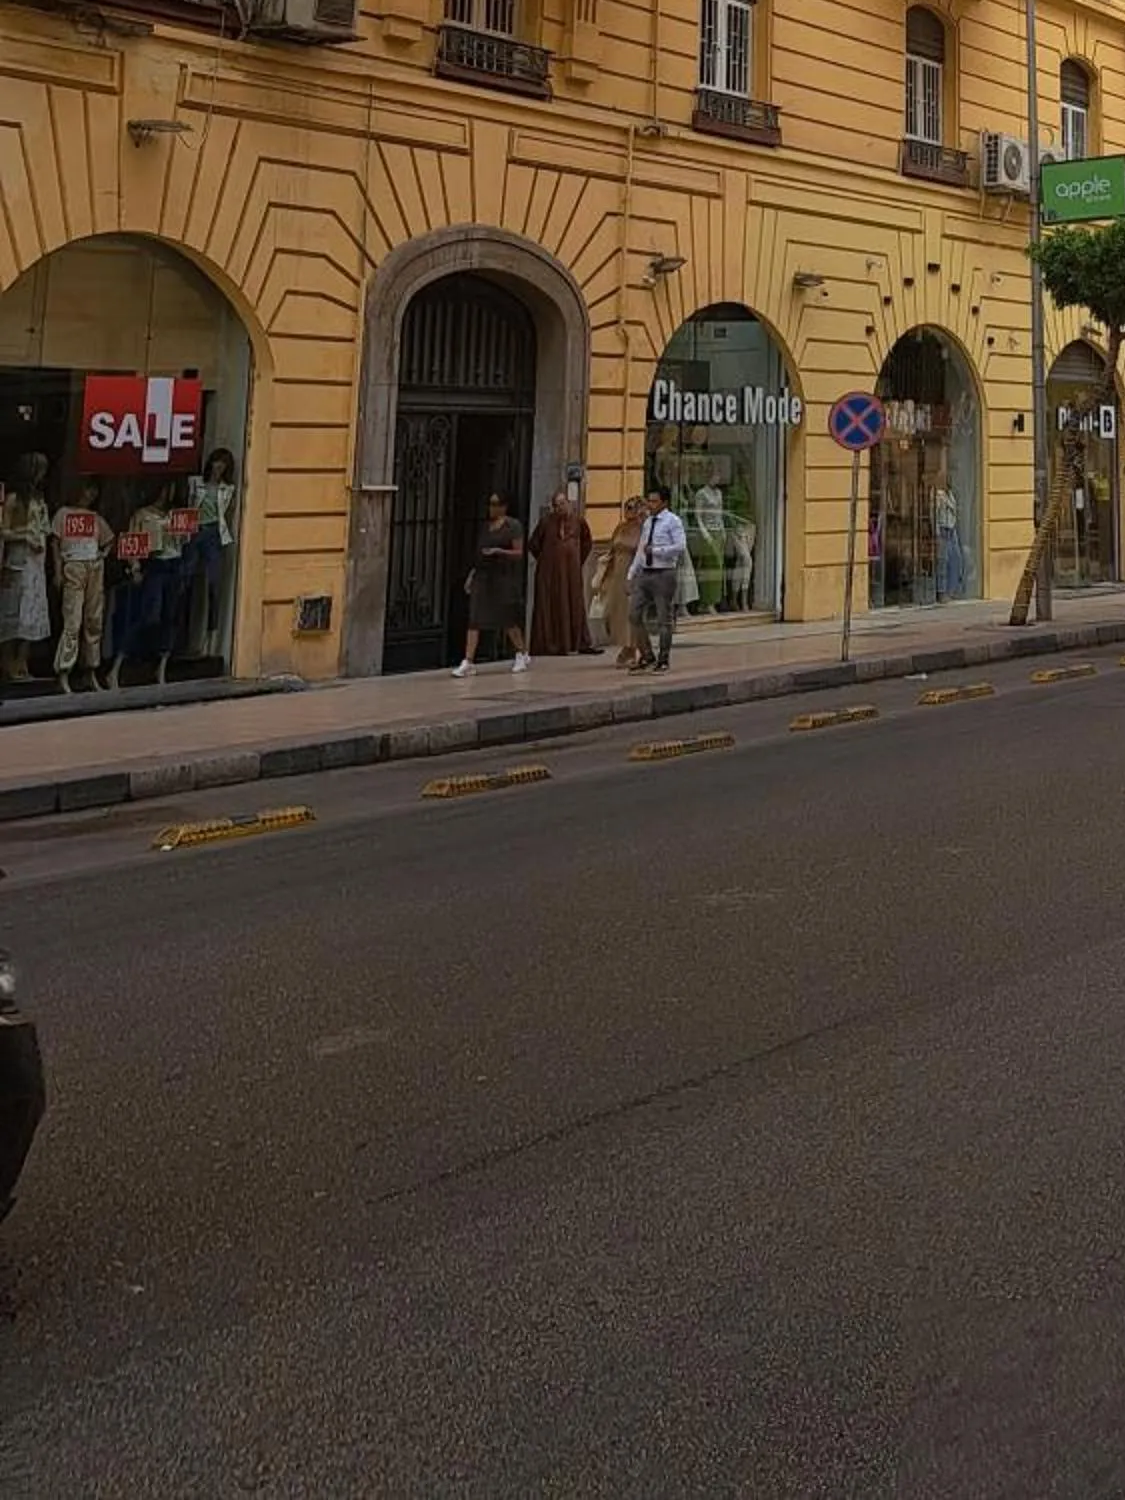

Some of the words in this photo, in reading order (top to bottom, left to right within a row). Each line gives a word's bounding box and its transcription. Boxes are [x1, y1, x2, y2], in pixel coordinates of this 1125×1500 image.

[1055, 172, 1111, 199] apple
[653, 379, 737, 422] Chance
[744, 386, 801, 425] Mode
[89, 411, 196, 449] SALE
